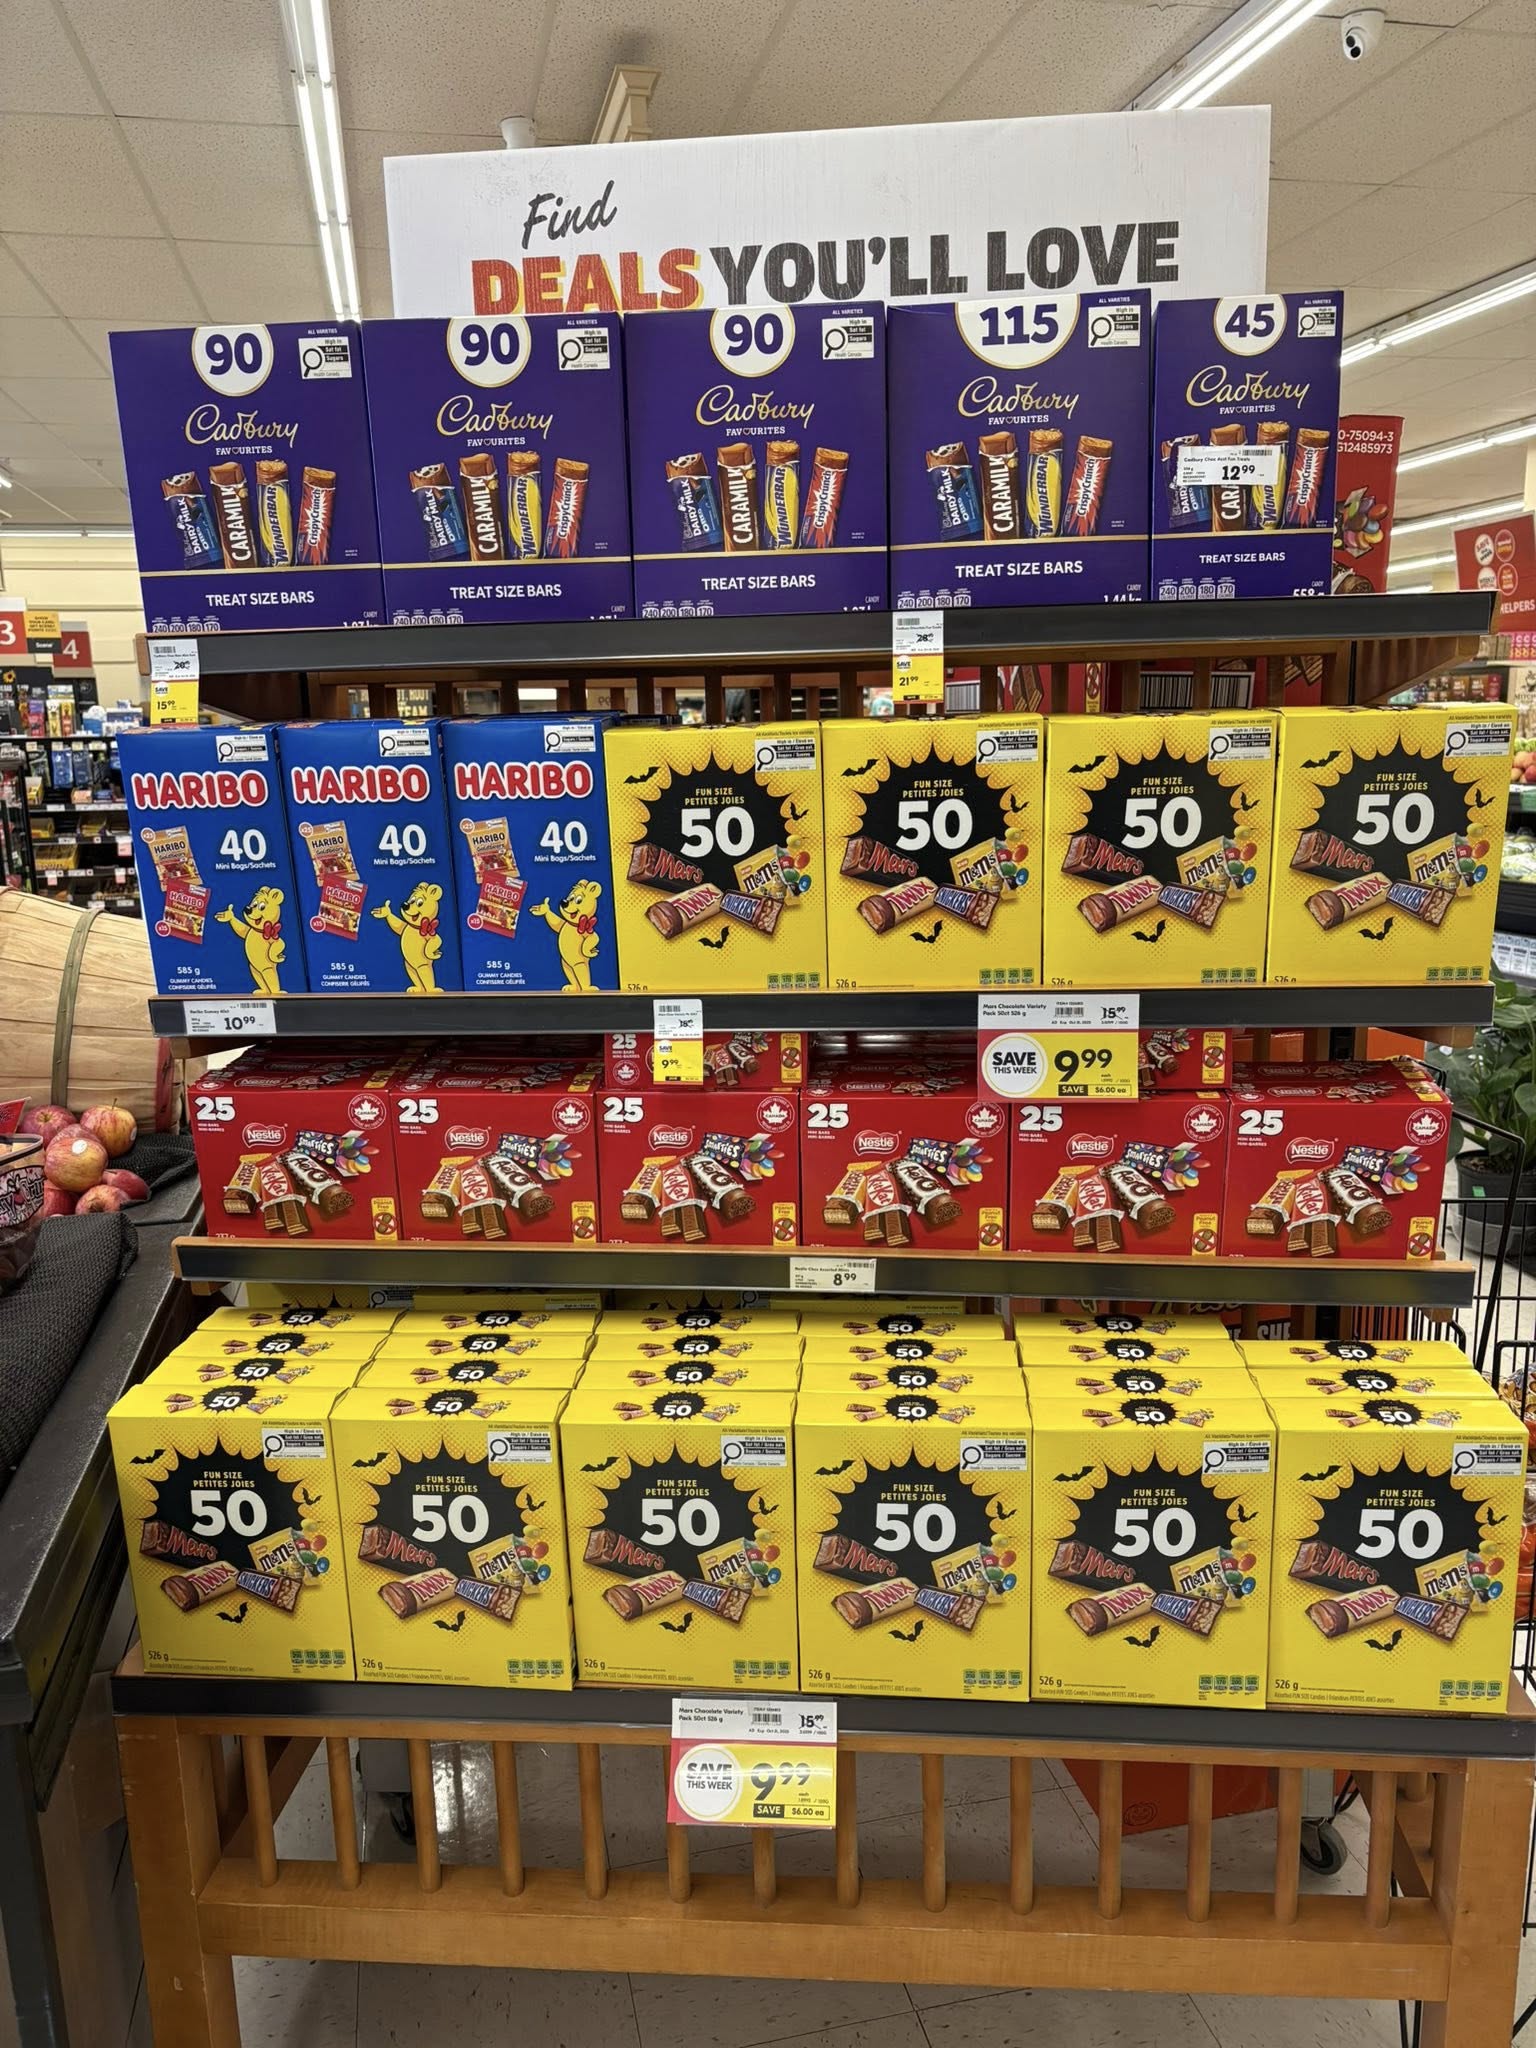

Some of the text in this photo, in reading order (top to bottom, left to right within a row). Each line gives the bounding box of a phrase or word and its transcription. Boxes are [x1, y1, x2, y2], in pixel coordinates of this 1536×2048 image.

[521, 180, 617, 249] Find
[472, 222, 1179, 316] DEALS YOU'LL LOVE
[724, 314, 784, 356] 90
[980, 302, 1060, 346] 115
[1224, 303, 1275, 338] 45
[205, 333, 263, 375] 90
[461, 323, 518, 366] 90
[957, 375, 1080, 419] Cadbury
[1185, 364, 1310, 409] Cadbury
[437, 395, 554, 439] Cadbury
[695, 385, 816, 429] Cadbury
[185, 404, 299, 448] Cadbury
[729, 465, 757, 545] CARAMILK
[990, 455, 1015, 533] CARAMILK
[219, 483, 252, 562] CARAMILK
[468, 476, 499, 555] CARAMILK
[955, 560, 1083, 578] TREAT SIZE BARS
[1199, 551, 1286, 563] TREAT SIZE BARS
[450, 584, 562, 600] TREAT SIZE BARS
[701, 574, 816, 591] TREAT SIZE BARS
[205, 590, 315, 607] TREAT SIZE BARS
[62, 639, 80, 660] 4
[131, 770, 268, 810] HARIBO
[291, 764, 430, 804] HARIBO
[454, 760, 593, 800] HARIBO
[695, 787, 733, 797] FUN SIZE
[685, 795, 744, 806] PETITES JOIES
[680, 805, 755, 859] 50
[896, 798, 973, 852] 50
[1121, 795, 1202, 849] 50
[1352, 792, 1435, 846] 50
[154, 841, 186, 854] HARIBO
[219, 829, 267, 861] 40
[311, 836, 344, 849] HARIBO
[378, 824, 427, 857] 40
[471, 832, 506, 846] HARIBO
[540, 820, 588, 854] 40
[215, 862, 230, 870] Mini
[373, 857, 388, 865] Mini
[534, 855, 549, 863] Mini
[486, 961, 510, 971] 585 g
[992, 1052, 1036, 1066] SAVE
[194, 1096, 236, 1121] 25
[398, 1098, 439, 1124] 25
[603, 1097, 644, 1122] 25
[807, 1103, 850, 1128] 25
[1018, 1105, 1063, 1131] 25
[1237, 1109, 1284, 1136] 25
[209, 1396, 241, 1408] 50
[662, 1405, 692, 1417] 50
[645, 1488, 710, 1497] PETITES JOIES
[657, 1479, 697, 1487] FUN SIZE
[1380, 1489, 1423, 1498] FUN SIZE
[190, 1489, 268, 1537] 50
[1366, 1498, 1436, 1507] PETITES JOIES
[412, 1494, 490, 1544] 50
[640, 1498, 720, 1547] 50
[873, 1503, 957, 1553] 50
[1111, 1508, 1197, 1558] 50
[1355, 1508, 1444, 1560] 50
[684, 1582, 725, 1607] SNICKERS
[1275, 1679, 1291, 1690] 526
[687, 1781, 733, 1790] THIS WEEK
[757, 1805, 781, 1815] SAVE
